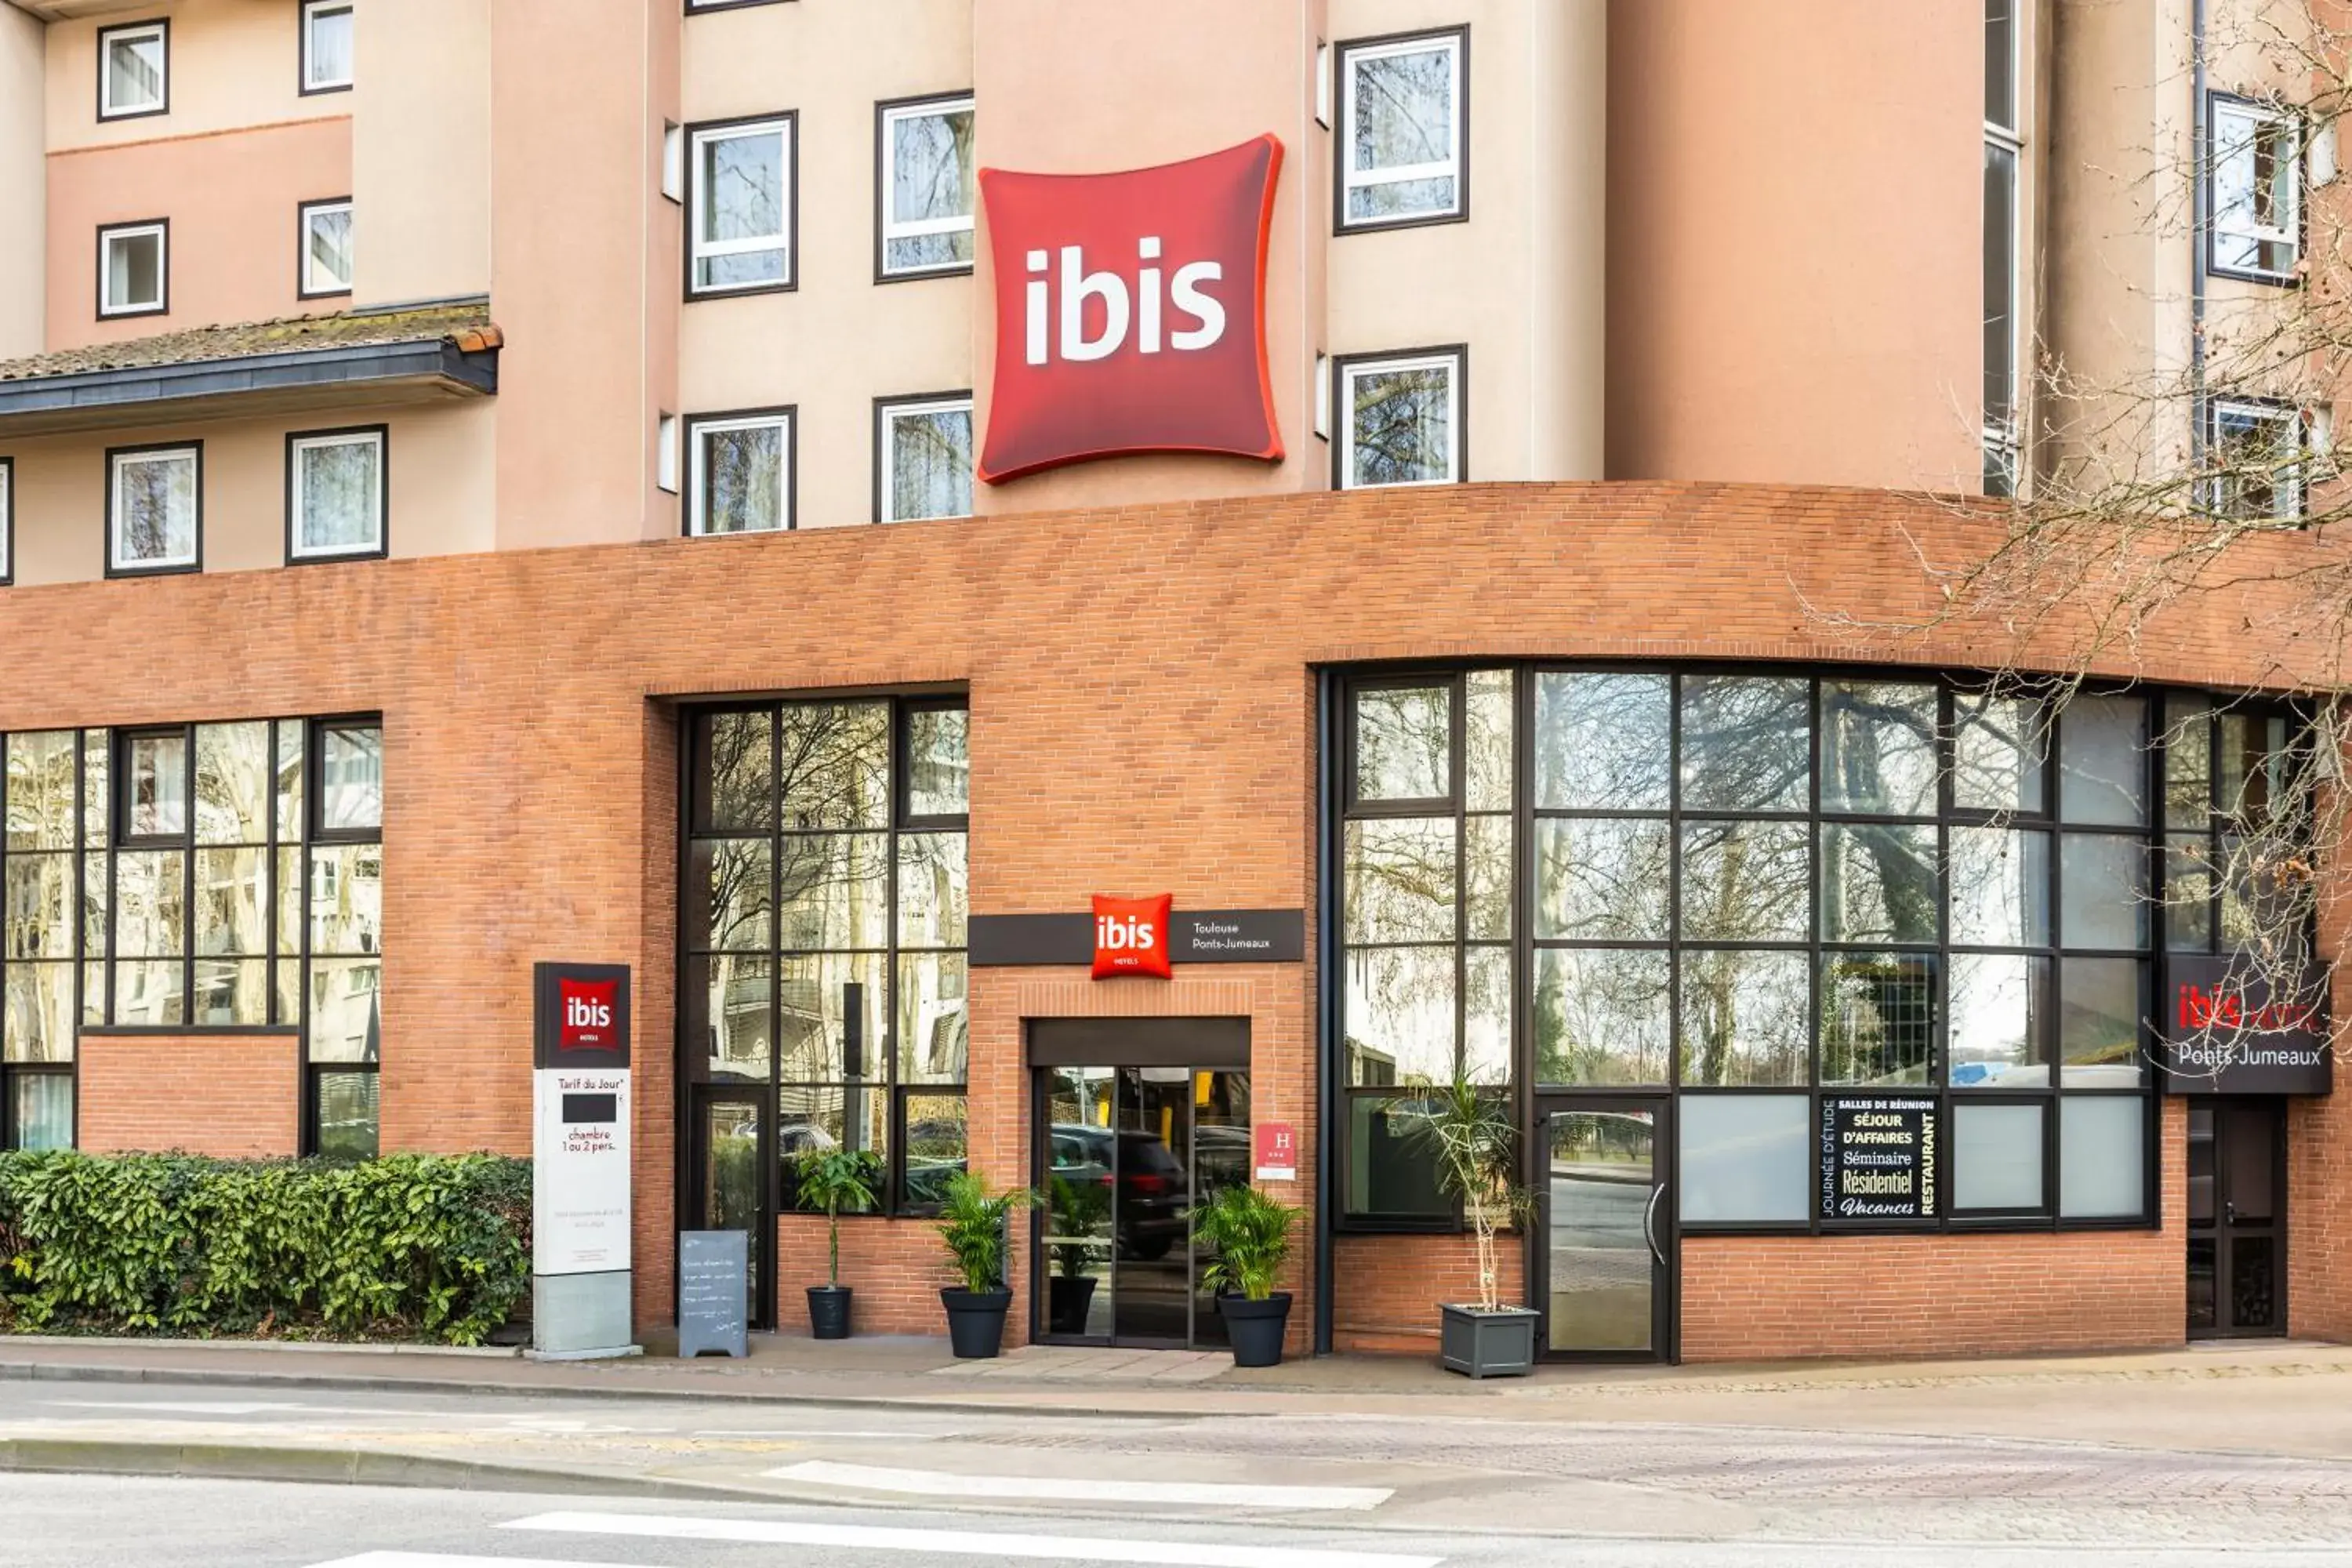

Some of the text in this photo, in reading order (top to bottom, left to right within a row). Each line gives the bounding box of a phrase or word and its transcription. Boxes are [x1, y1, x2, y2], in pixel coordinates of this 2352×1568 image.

[1025, 235, 1226, 365] ibis
[1098, 915, 1155, 950] ibis
[1193, 922, 1240, 934] Toulouse
[1192, 938, 1271, 949] Ponts-Jumeaux
[567, 996, 611, 1027] ibis
[2179, 982, 2240, 1029] ibis
[2179, 1043, 2321, 1065] Ponts-Jumeaux
[557, 1078, 580, 1089] Tarif
[583, 1078, 596, 1089] du
[1838, 1098, 1934, 1109] SALLES DE RÉUNION
[1853, 1112, 1903, 1127] SÉJOUR
[568, 1127, 611, 1141] chambre
[1276, 1133, 1290, 1149] H
[1843, 1131, 1913, 1144] D'AFFAIRES
[568, 1142, 581, 1152] ou
[583, 1141, 590, 1151] 2
[1820, 1099, 1835, 1217] JOURNÉE D'ÉTUDE
[1843, 1150, 1912, 1165] Séminaire
[1922, 1113, 1934, 1214] RESTAURANT
[1843, 1169, 1912, 1194] Résidentiel
[1840, 1197, 1915, 1215] Vacances
